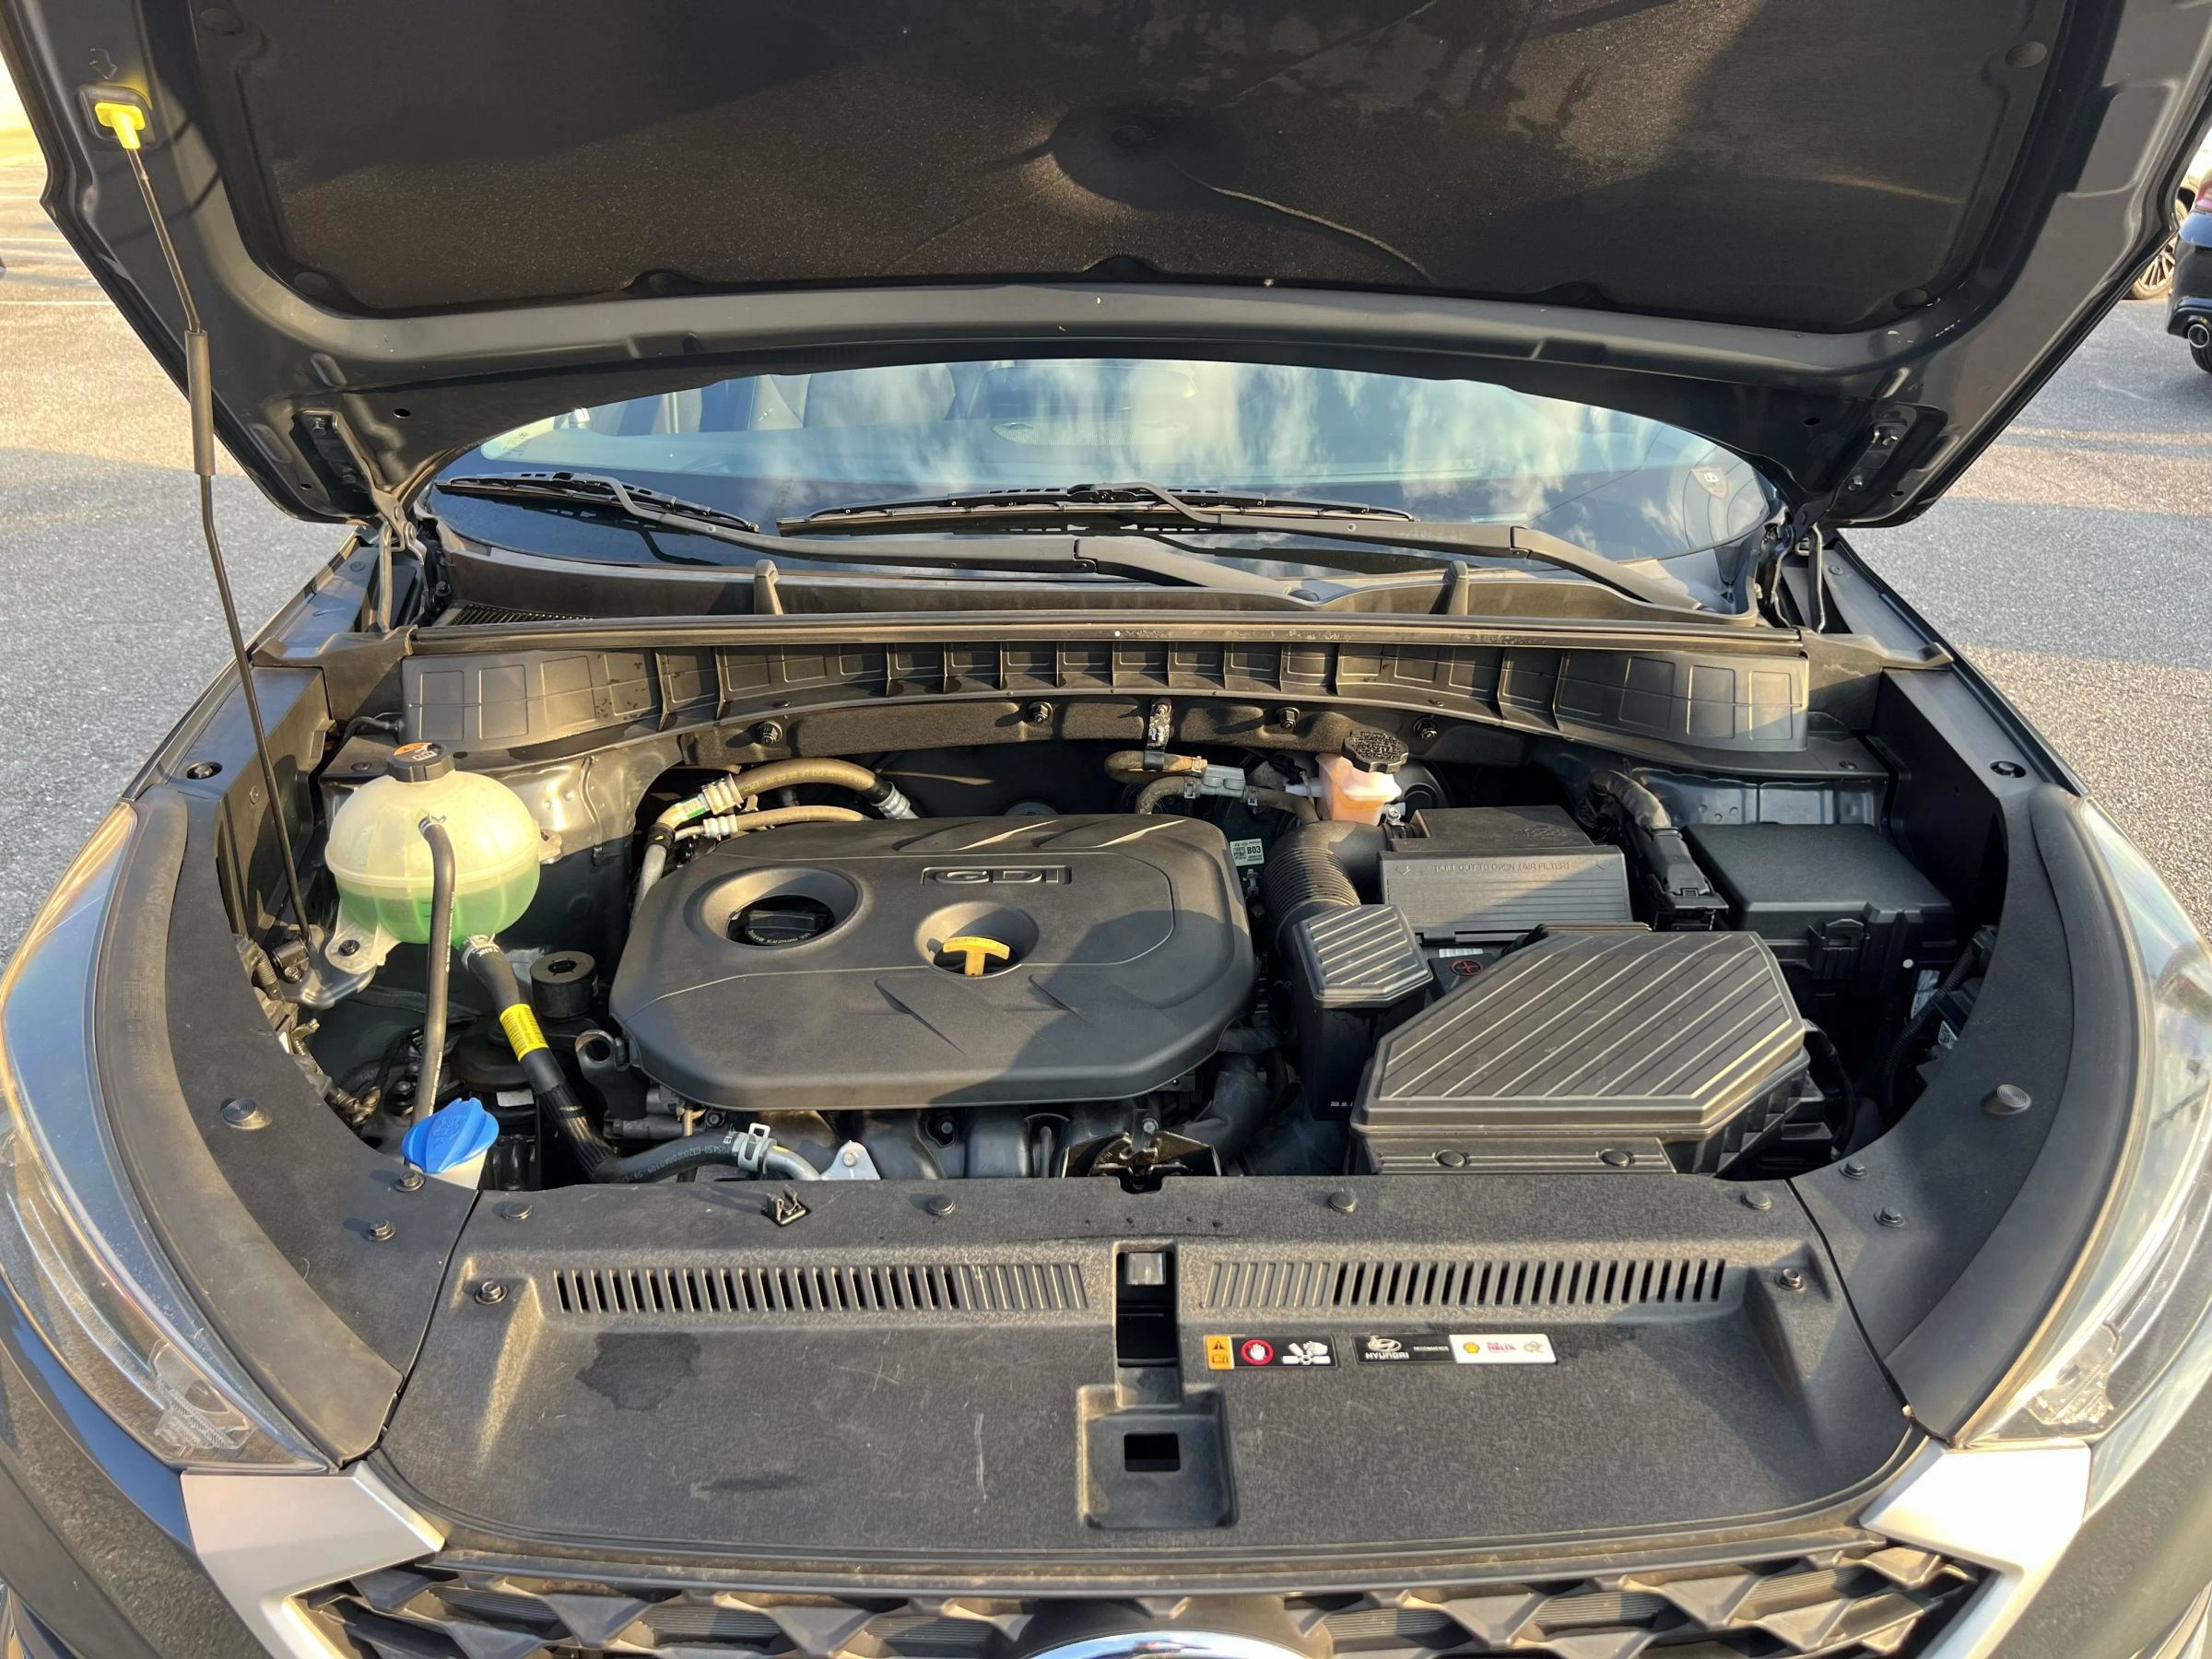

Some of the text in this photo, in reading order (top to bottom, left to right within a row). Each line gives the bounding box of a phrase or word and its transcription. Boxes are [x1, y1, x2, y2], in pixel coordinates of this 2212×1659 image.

[1247, 845, 1262, 854] B03
[1478, 863, 1490, 871] TO
[1492, 862, 1515, 871] OPEN
[1538, 861, 1571, 871] FILTER)
[933, 868, 1060, 885] GDI
[1365, 1351, 1410, 1360] HYUNDAI
